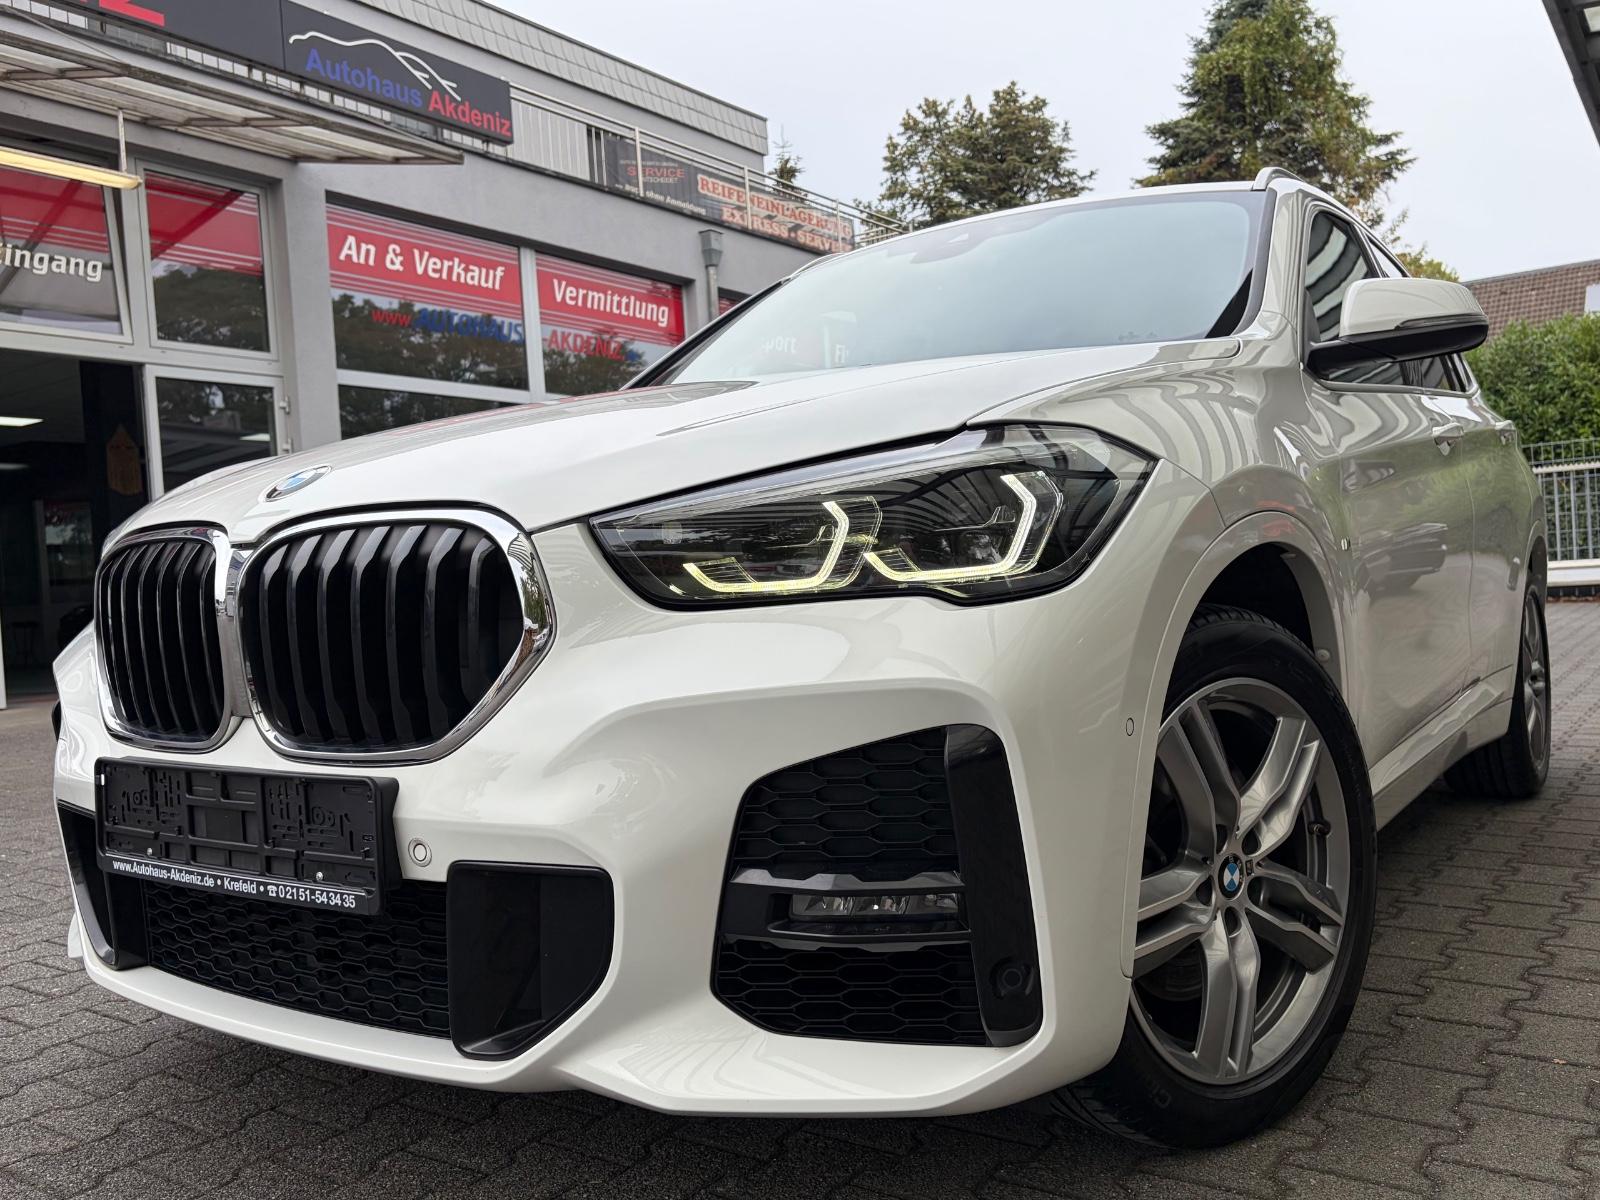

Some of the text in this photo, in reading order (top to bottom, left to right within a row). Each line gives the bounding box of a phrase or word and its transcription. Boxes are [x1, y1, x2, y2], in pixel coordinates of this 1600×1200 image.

[304, 47, 512, 137] Autohaus Akdeniz
[0, 243, 103, 283] ingang
[339, 235, 505, 291] An & Verkauf
[552, 278, 670, 328] Vermittlung
[112, 859, 215, 888] www.Autohaus-Akdeniz.de
[223, 879, 257, 895] Krefeld
